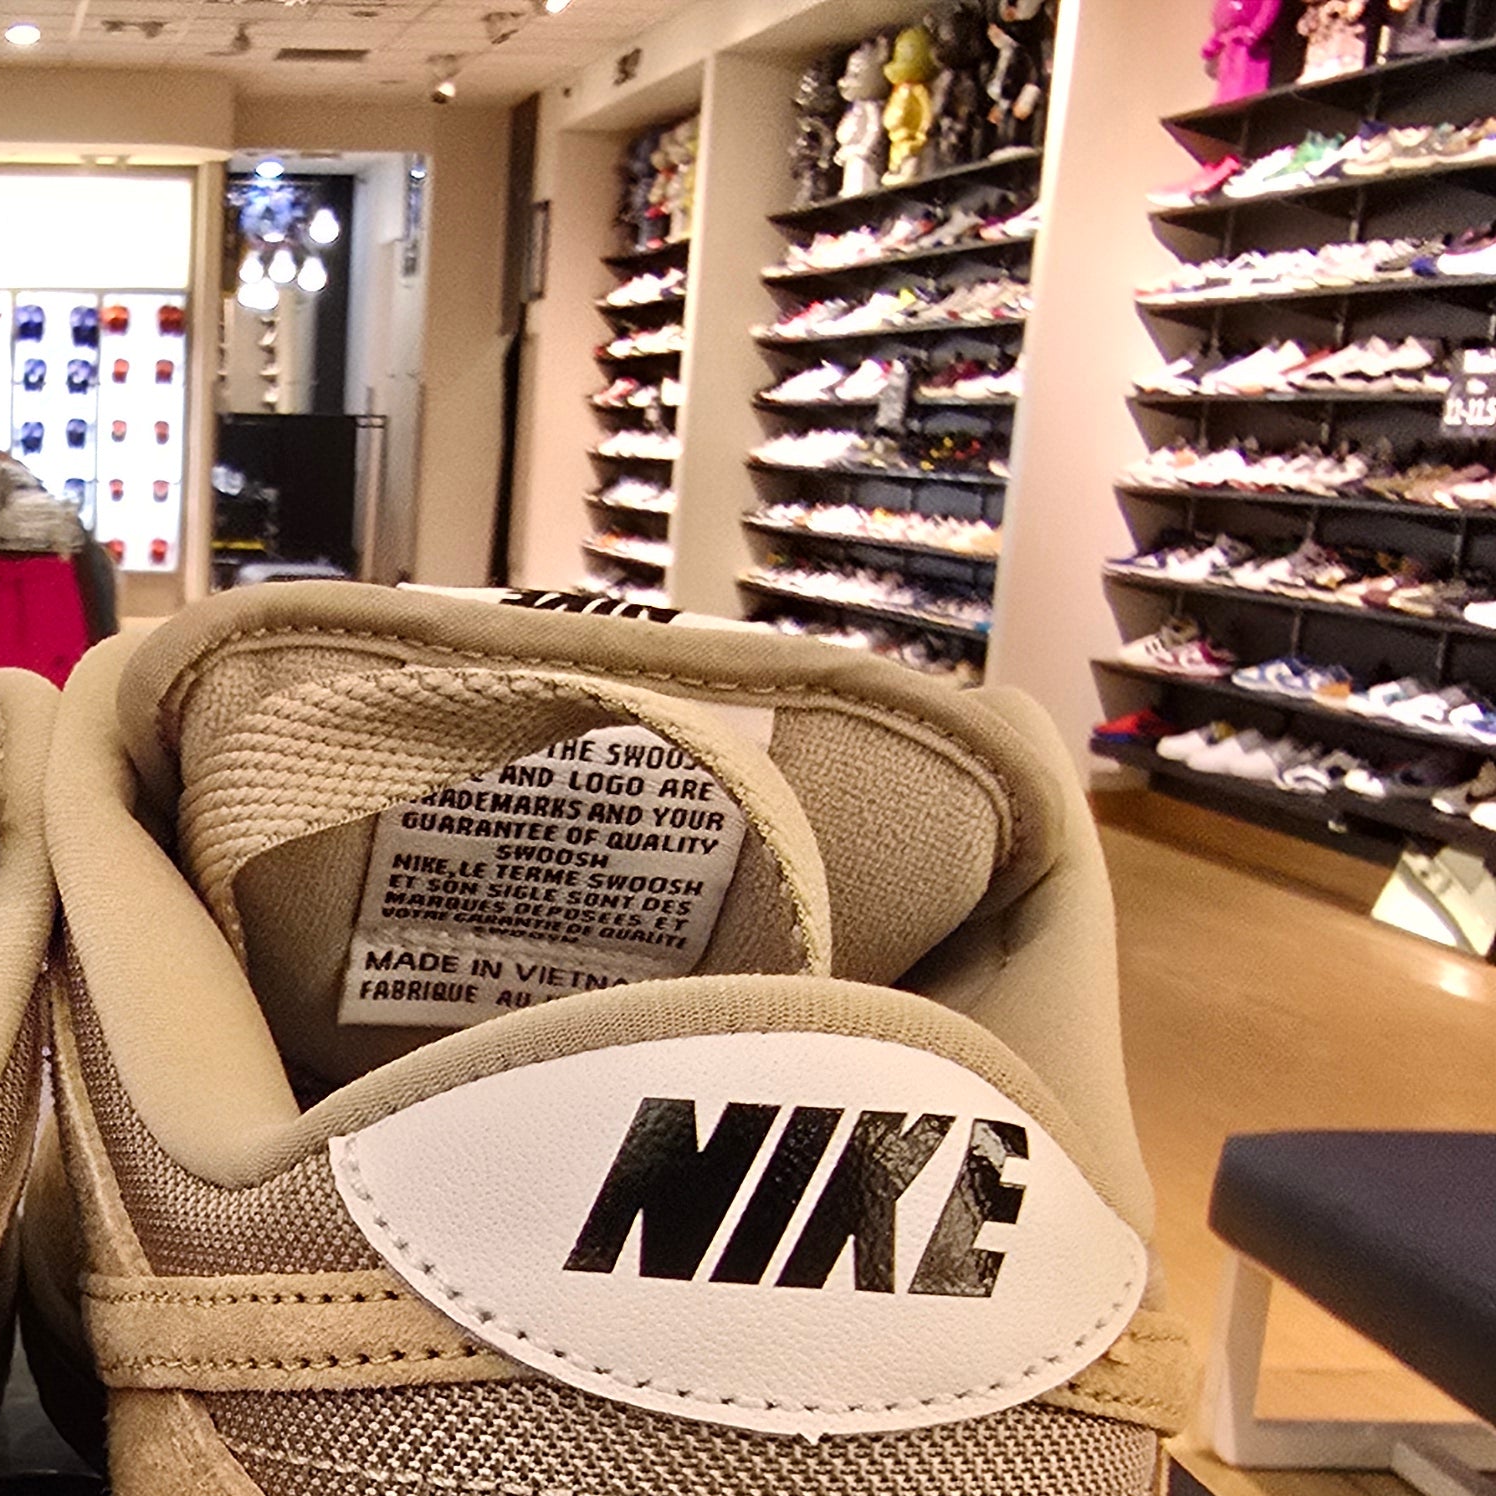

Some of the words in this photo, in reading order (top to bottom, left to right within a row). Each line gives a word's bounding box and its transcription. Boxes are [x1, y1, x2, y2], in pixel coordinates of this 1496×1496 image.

[498, 764, 554, 788] AND
[568, 770, 645, 797] LOGO
[658, 778, 715, 802] ARE
[410, 788, 583, 820] RADEMARKS
[587, 802, 644, 826] AND
[653, 806, 726, 832] YOUR
[402, 811, 560, 843] GUARANTEE
[566, 826, 600, 846] OF
[606, 831, 719, 856] QUALITY
[494, 844, 609, 869] SWOOSH
[388, 874, 416, 889] ET
[426, 878, 479, 895] SON
[486, 883, 558, 903] SIGLE
[566, 890, 635, 910] SONT
[641, 897, 692, 917] DES
[495, 864, 581, 887] TERME
[587, 873, 704, 897] SWOOSH
[383, 891, 506, 914] MARQUES
[654, 917, 689, 932] ET
[364, 951, 460, 974] MADE
[471, 959, 503, 980] IN
[360, 980, 479, 1004] FABRIQUE
[495, 990, 532, 1009] AU
[562, 1097, 1030, 1299] NIKE
